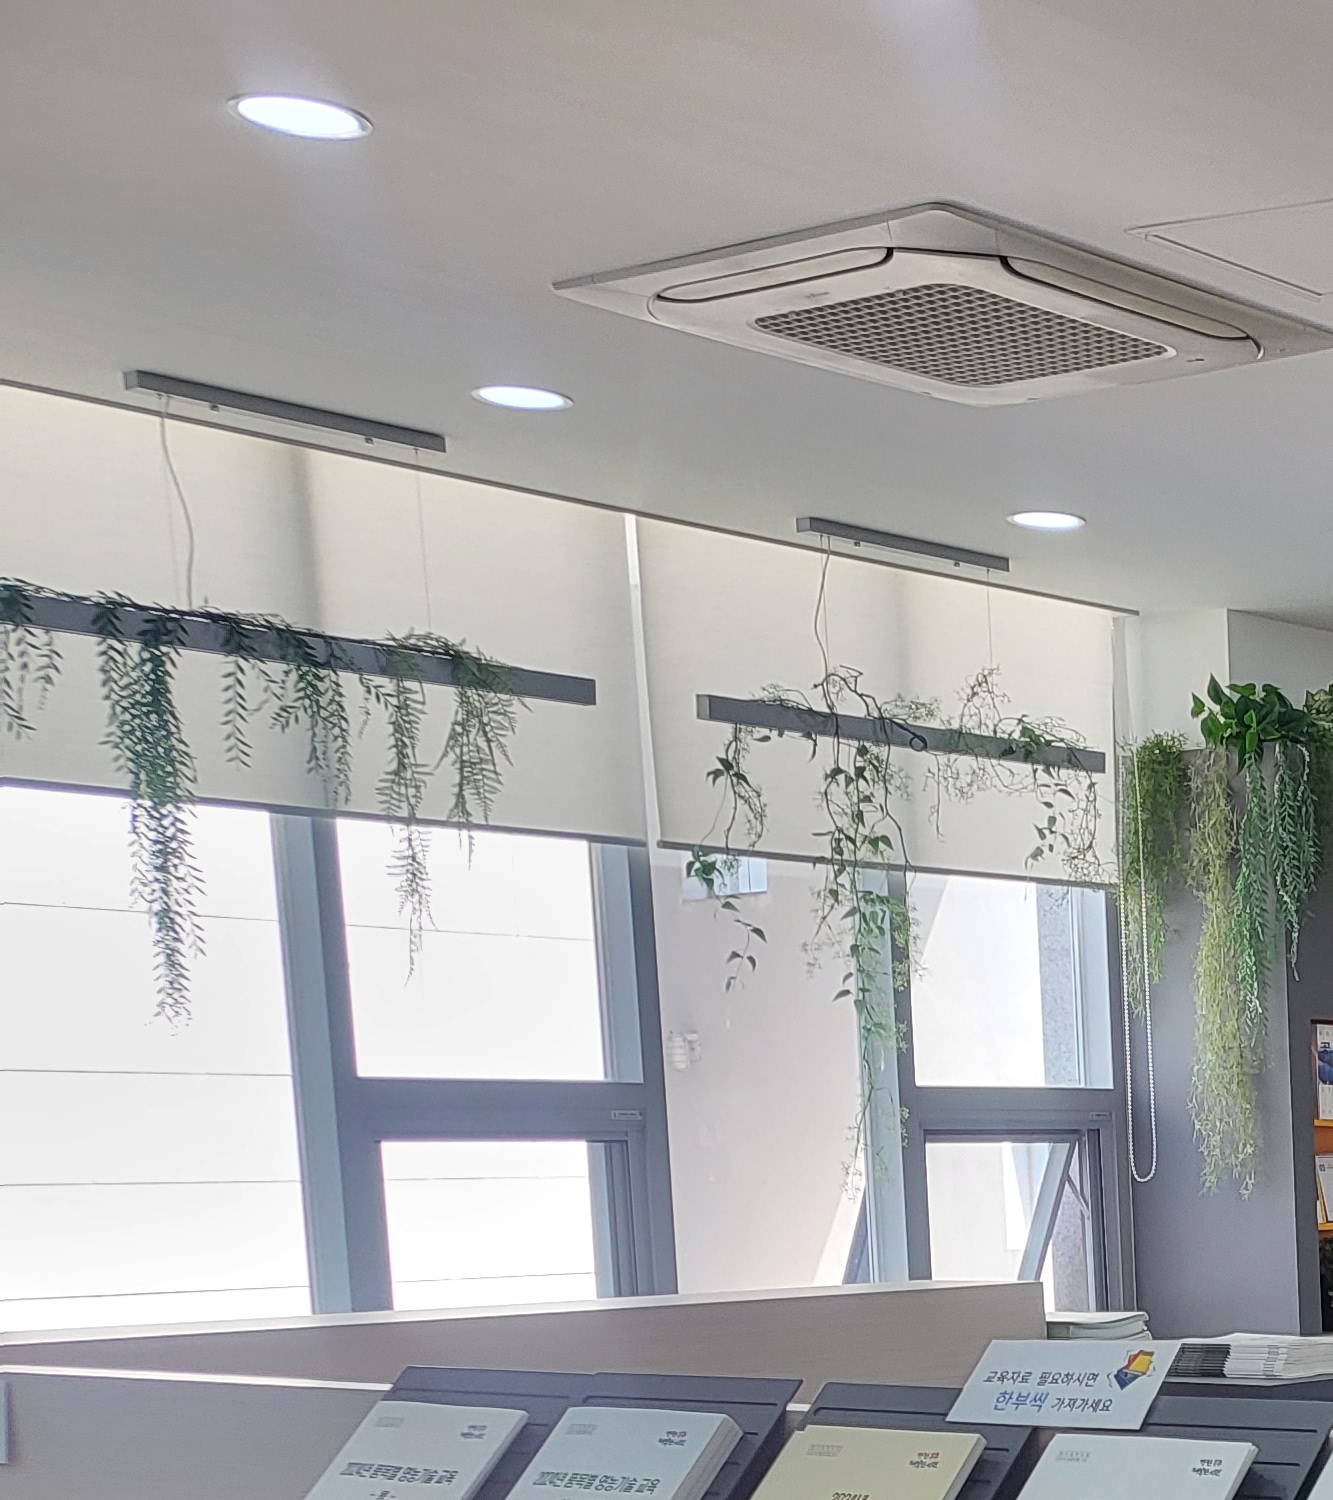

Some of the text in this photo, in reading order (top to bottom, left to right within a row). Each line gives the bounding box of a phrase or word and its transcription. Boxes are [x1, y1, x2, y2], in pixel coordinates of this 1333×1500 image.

[983, 1370, 1099, 1388] 교육자료 필요하시면
[994, 1390, 1113, 1413] 한부씩 가져가세요
